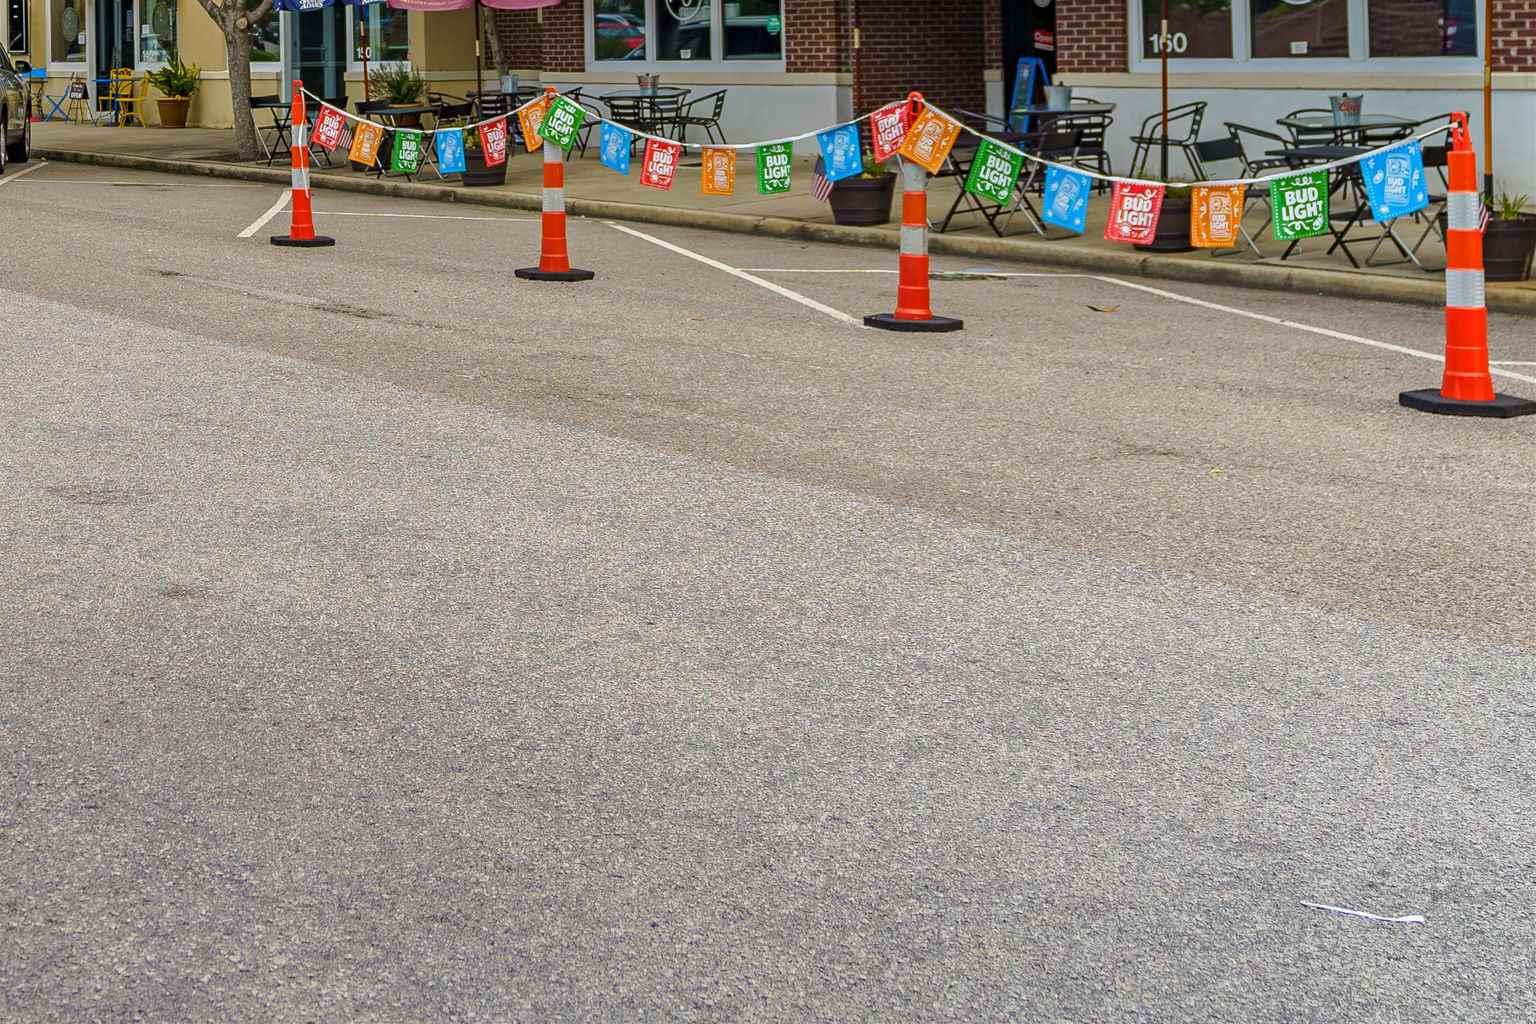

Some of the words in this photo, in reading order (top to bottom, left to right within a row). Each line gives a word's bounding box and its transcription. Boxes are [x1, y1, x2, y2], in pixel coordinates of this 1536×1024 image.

[1149, 32, 1187, 53] 160
[324, 116, 339, 129] BUD
[554, 109, 575, 126] BUD
[878, 111, 900, 131] BUD
[320, 123, 339, 138] LIGHT
[548, 117, 573, 135] LIGHT
[486, 129, 504, 142] BUD
[878, 123, 904, 146] LIGHT
[402, 140, 417, 150] BUD
[399, 150, 418, 160] LIGHT
[652, 152, 673, 165] BUD
[766, 154, 788, 167] BUD
[649, 162, 675, 175] LIGHT
[764, 165, 791, 179] LIGHT
[985, 155, 1012, 175] BUD
[979, 167, 1012, 187] LIGHT
[1122, 196, 1153, 212] BUD
[1284, 187, 1319, 205] BUD
[1116, 210, 1154, 226] LIGHT
[1281, 202, 1324, 220] LIGHT
